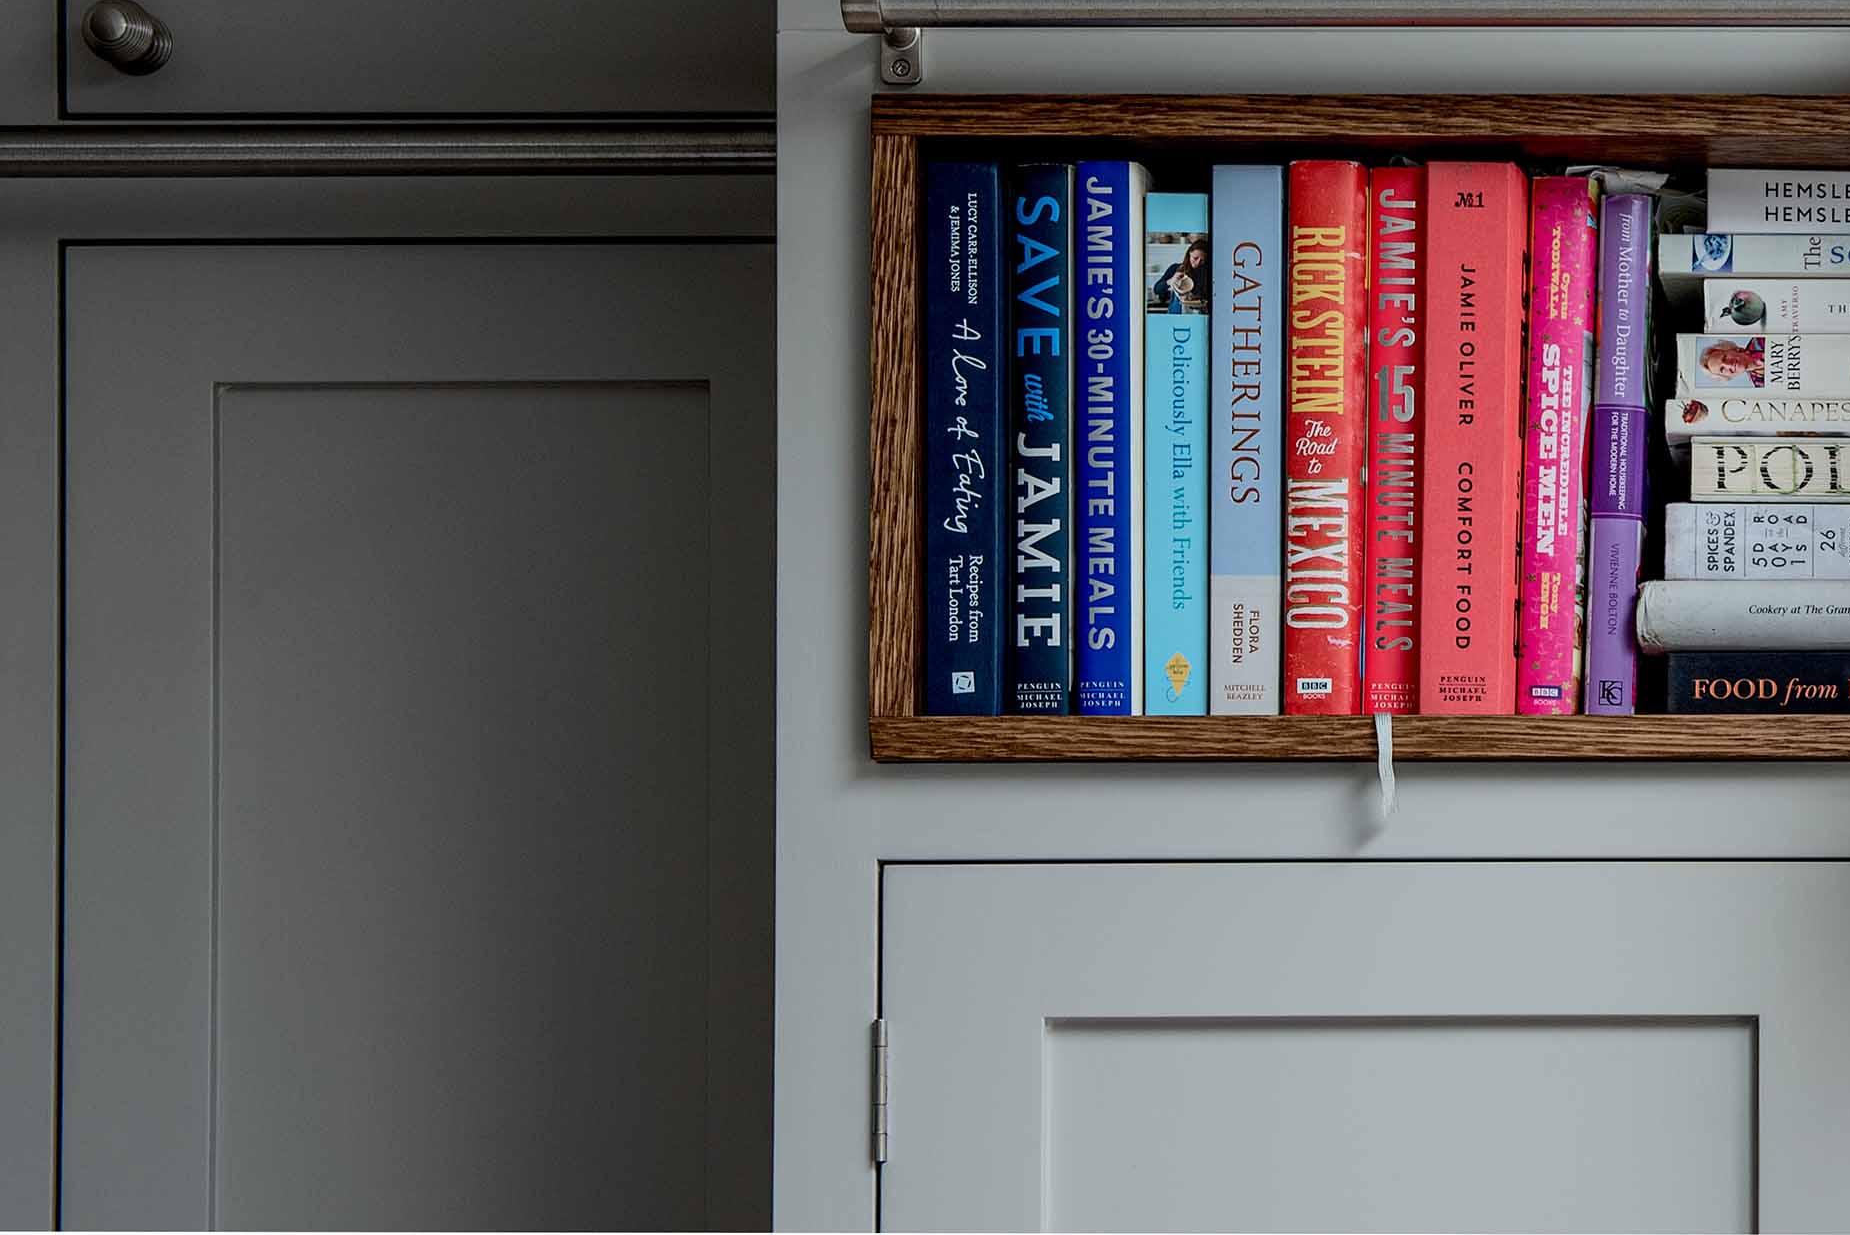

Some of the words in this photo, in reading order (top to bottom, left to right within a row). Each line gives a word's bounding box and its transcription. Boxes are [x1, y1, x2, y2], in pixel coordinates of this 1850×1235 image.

[949, 205, 961, 213] &
[967, 192, 978, 221] LUCY
[1618, 213, 1633, 243] from
[949, 213, 961, 257] JEMIMA
[1803, 236, 1822, 270] The
[949, 258, 961, 293] JONES
[967, 223, 978, 306] CARR-ELLISON
[1016, 195, 1061, 358] SAVE
[1291, 225, 1346, 306] RICK
[1615, 247, 1633, 305] Mother
[1459, 263, 1476, 333] JAMIE
[1616, 308, 1631, 321] to
[951, 317, 983, 342] A
[1164, 326, 1193, 437] Deliciously
[1230, 241, 1264, 505] GATHERINGS
[1291, 307, 1346, 415] STEIN
[1610, 325, 1632, 399] Daughter
[1770, 339, 1785, 384] MARY
[1023, 373, 1055, 423] with
[1374, 364, 1416, 423] 15
[1457, 341, 1475, 426] OLIVER
[1538, 343, 1561, 460] SPICE
[1561, 364, 1573, 406] THE
[946, 415, 980, 442] of
[1086, 328, 1115, 517] 30-MINUTE
[1304, 419, 1333, 438] The
[1610, 428, 1618, 441] THE
[1611, 411, 1619, 427] FOR
[1619, 412, 1629, 457] TRADITIONAL
[1171, 443, 1193, 480] Ella
[1295, 437, 1339, 456] Road
[1306, 456, 1323, 475] to
[1609, 442, 1618, 473] MODERN
[942, 448, 986, 534] Eating
[1376, 432, 1415, 544] MINUTE
[1557, 409, 1572, 537] INCREDIBLE
[1608, 474, 1617, 497] HOME
[1617, 458, 1627, 510] HOUSEKEEPING
[1172, 488, 1193, 534] with
[1456, 461, 1473, 575] COMFORT
[1535, 465, 1557, 558] MEN
[1753, 512, 1809, 525] ROAD
[1016, 431, 1062, 647] JAMIE
[1285, 478, 1350, 630] MEXICO
[1707, 529, 1720, 572] SPICES
[1753, 542, 1808, 554] DAYS
[1819, 529, 1837, 552] 26
[948, 555, 964, 585] Tart
[966, 554, 984, 607] Recipes
[1171, 538, 1193, 611] Friends
[1608, 543, 1620, 591] VIVIENNE
[1087, 527, 1116, 651] MEALS
[1375, 557, 1414, 652] MEALS
[1748, 604, 1789, 617] Cookery
[1790, 606, 1800, 615] at
[1803, 604, 1823, 615] The
[948, 587, 964, 642] London
[967, 608, 984, 644] from
[1232, 603, 1244, 665] SHEDDEN
[1248, 609, 1260, 654] FLORA
[1455, 584, 1472, 650] FOOD
[1607, 592, 1618, 636] BOLTON
[1016, 682, 1062, 691] PENGUIN
[1079, 681, 1125, 690] PENGUIN
[1223, 684, 1267, 692] MITCHELL
[1226, 693, 1265, 701] BEAZLEY
[1301, 680, 1329, 691] BBC
[1302, 692, 1327, 700] BOOKS
[1438, 686, 1488, 694] MICHAEL
[1439, 676, 1487, 684] PENGUIN
[1442, 694, 1483, 702] JOSEPH
[1692, 677, 1778, 700] FOOD
[1779, 677, 1839, 705] from
[1019, 701, 1059, 709] JOSEPH
[1083, 700, 1122, 708] JOSEPH
